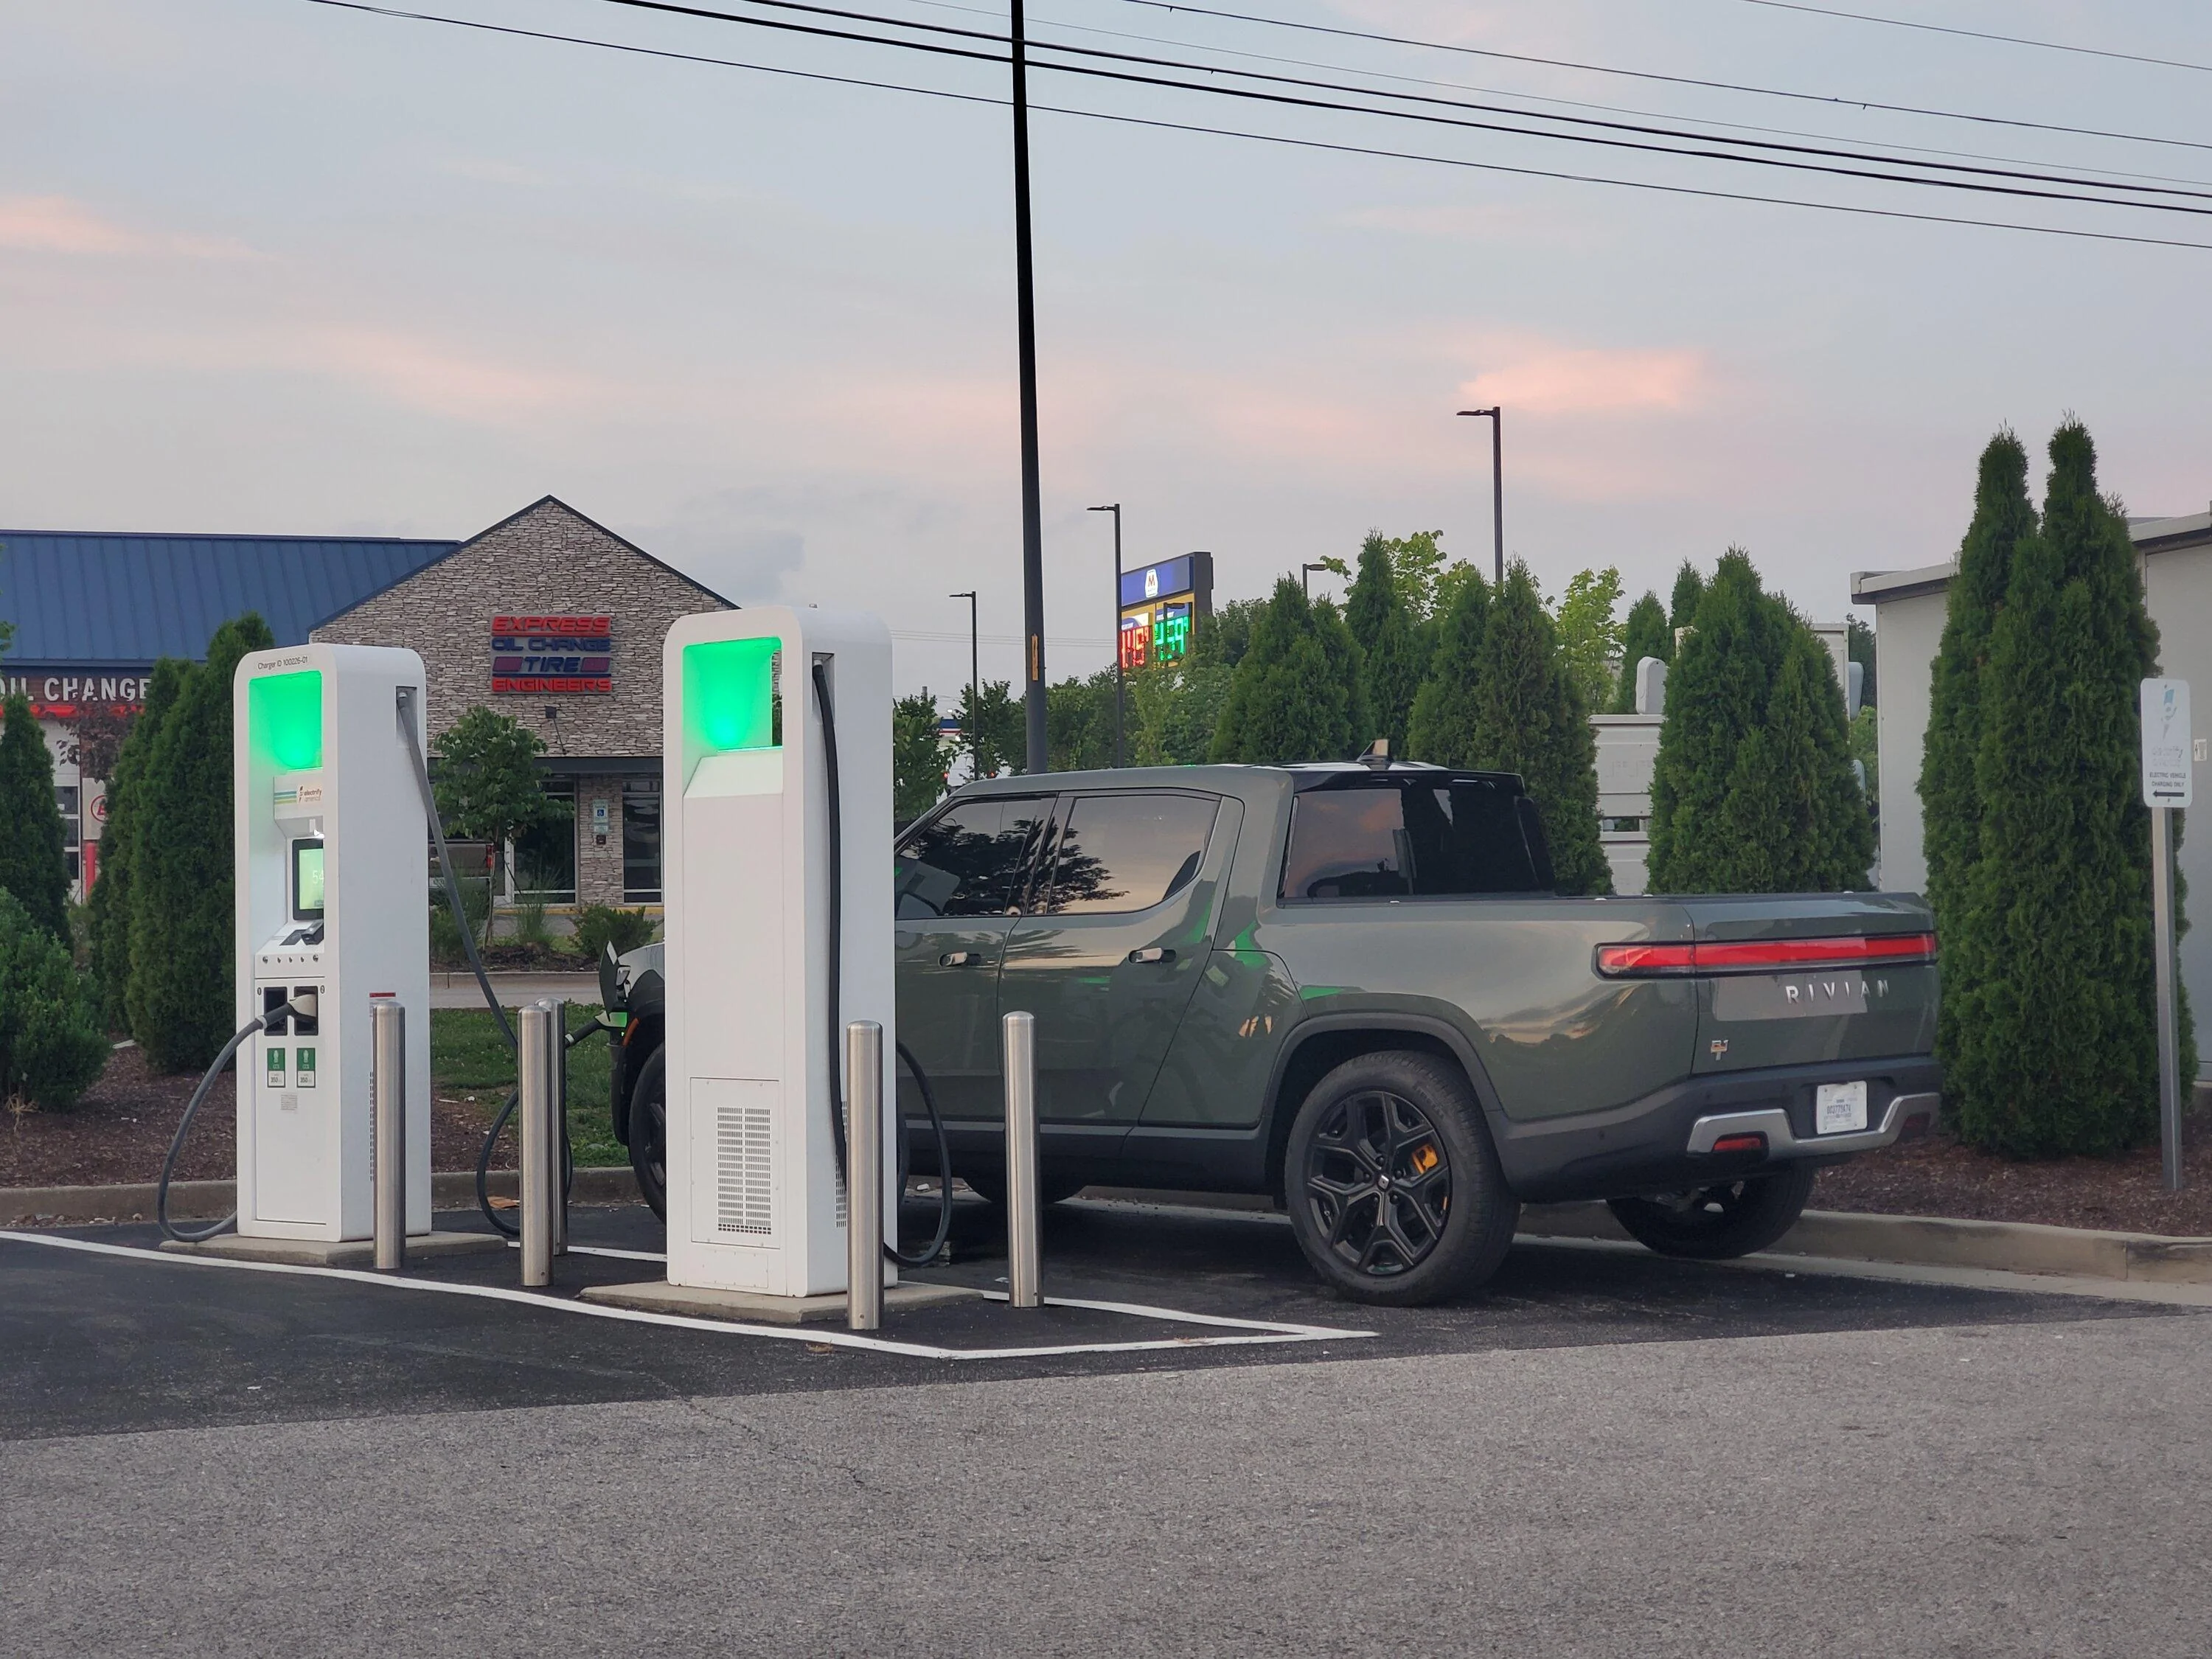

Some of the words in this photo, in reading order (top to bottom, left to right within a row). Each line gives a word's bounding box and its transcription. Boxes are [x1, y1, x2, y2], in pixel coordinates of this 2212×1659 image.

[1147, 574, 1155, 587] M
[492, 616, 611, 632] EXPRESS
[491, 637, 524, 651] OIL
[528, 638, 611, 652] CHANGE
[257, 661, 276, 670] Charger
[524, 656, 581, 672] TIRE
[44, 677, 152, 702] CHANGE
[492, 678, 612, 692] ENGINEERS
[1785, 979, 1889, 1004] RIVIAN
